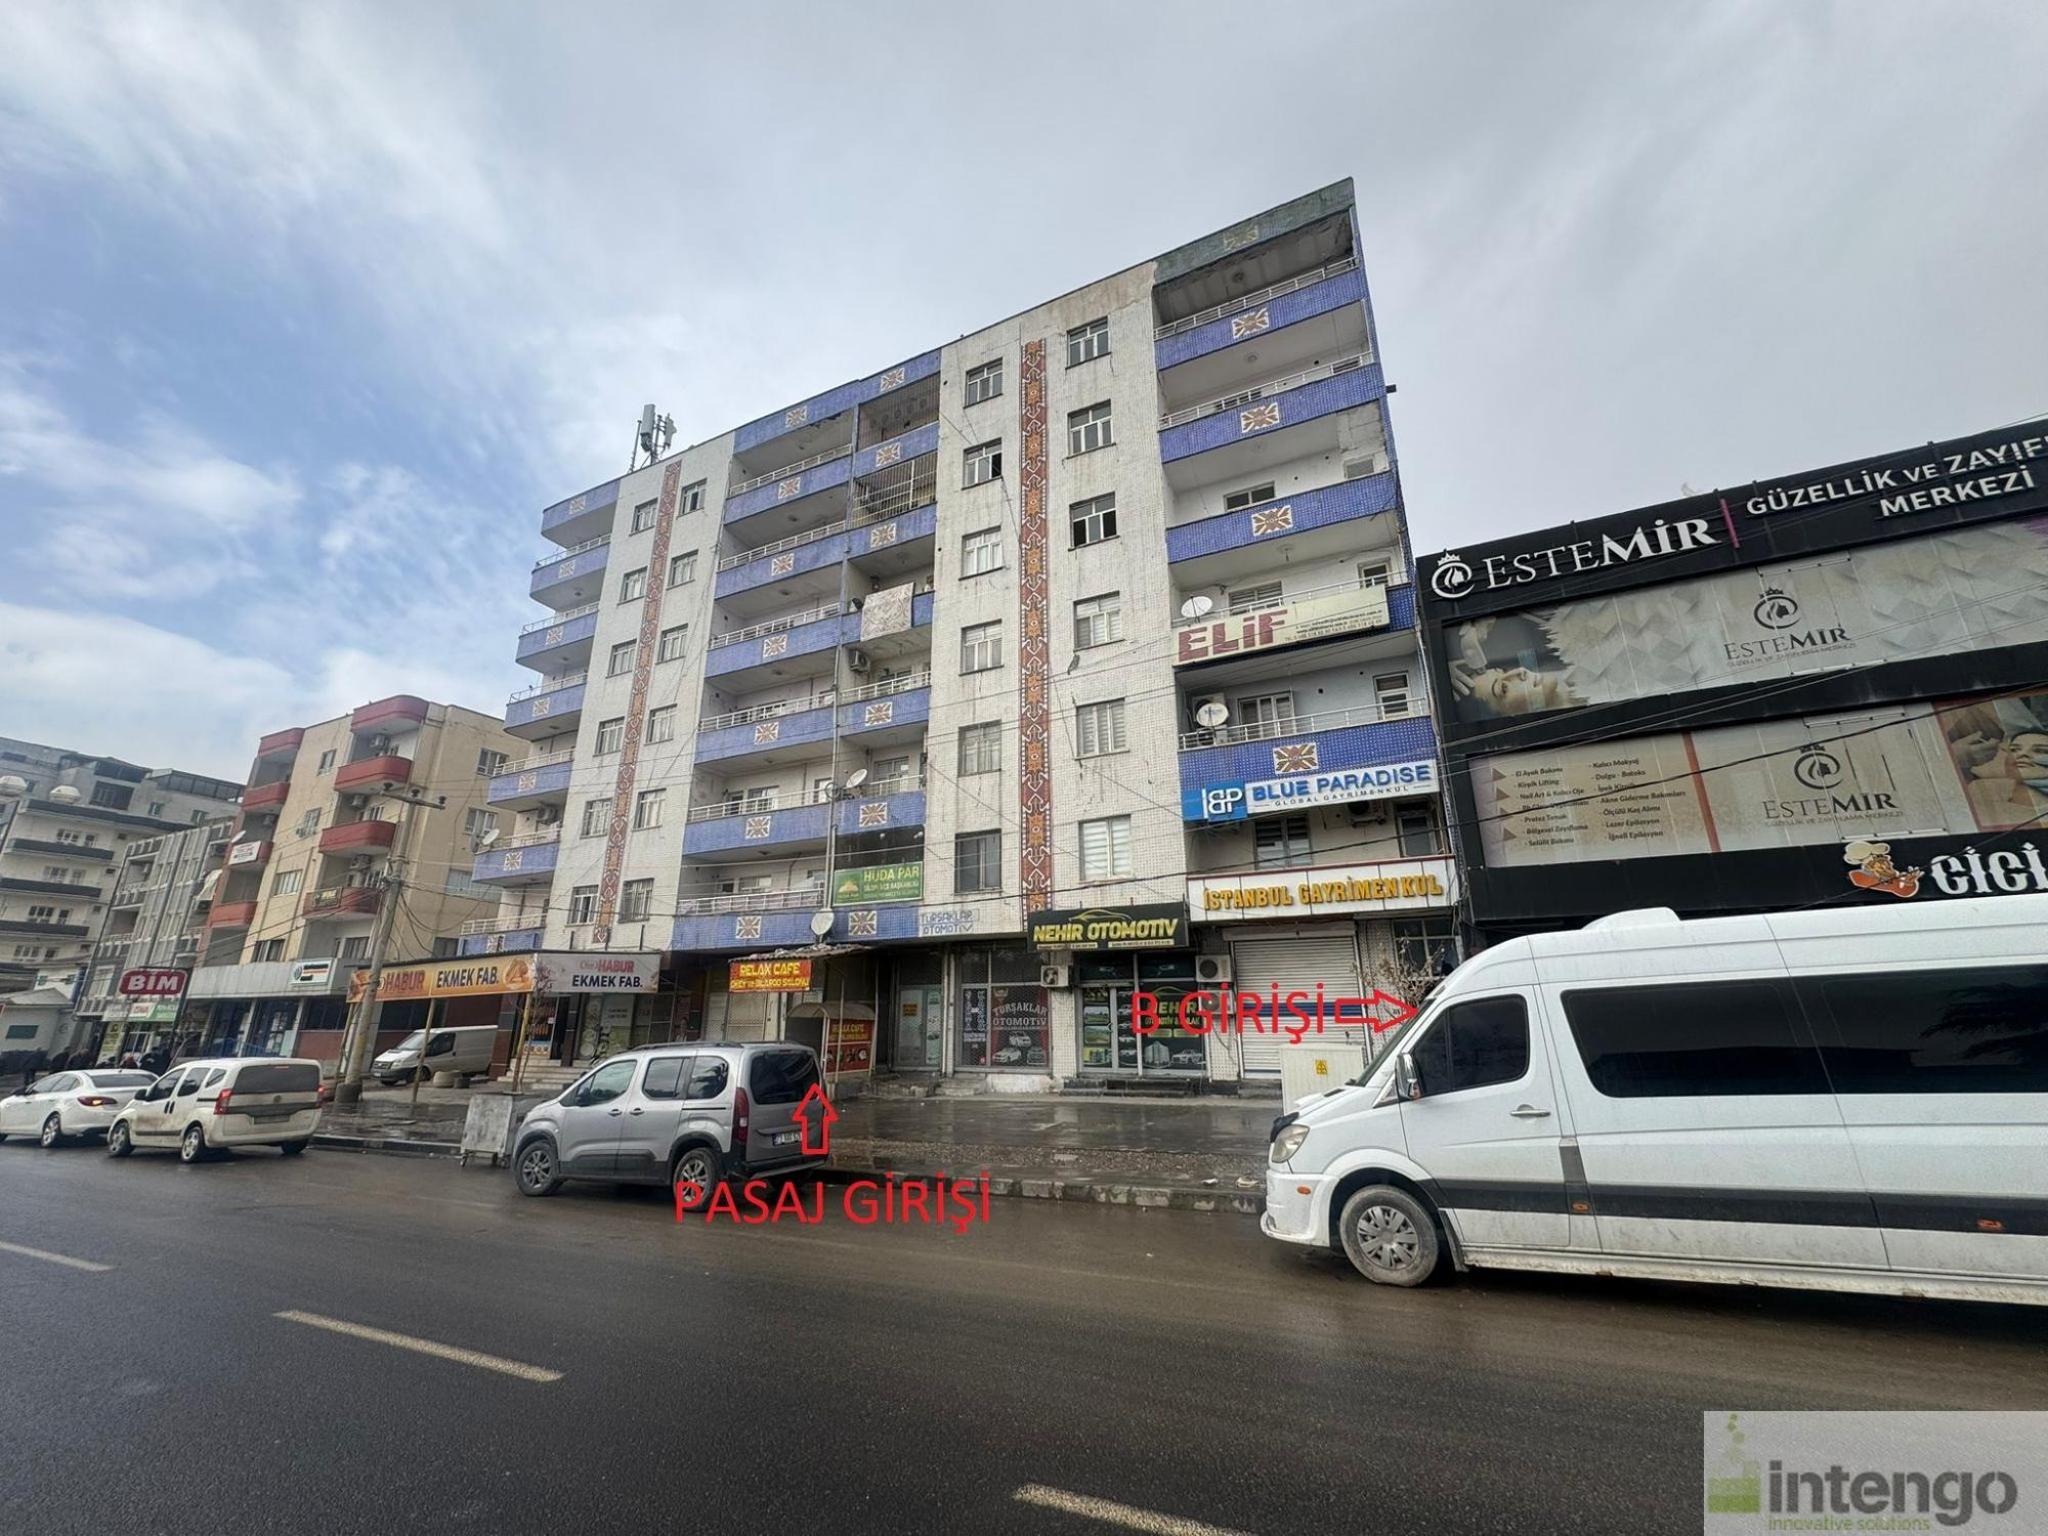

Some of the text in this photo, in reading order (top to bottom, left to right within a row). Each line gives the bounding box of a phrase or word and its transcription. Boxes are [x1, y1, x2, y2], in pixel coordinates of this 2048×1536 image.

[1746, 436, 2048, 516] GÜZELLİK VE ZAYIF
[1879, 465, 2035, 517] MERKEZİ
[1252, 764, 1431, 801] BLUE PARADISE
[1274, 796, 1319, 807] GLOBAL
[863, 866, 920, 882] HUDA PAR
[1203, 887, 1293, 911] İSTANBUL
[437, 966, 500, 988] EKMEK FAB.
[597, 960, 634, 973] HABUR
[740, 962, 772, 977] RELAX
[385, 969, 426, 992] HABUR
[572, 974, 643, 988] EKMEK FAB.
